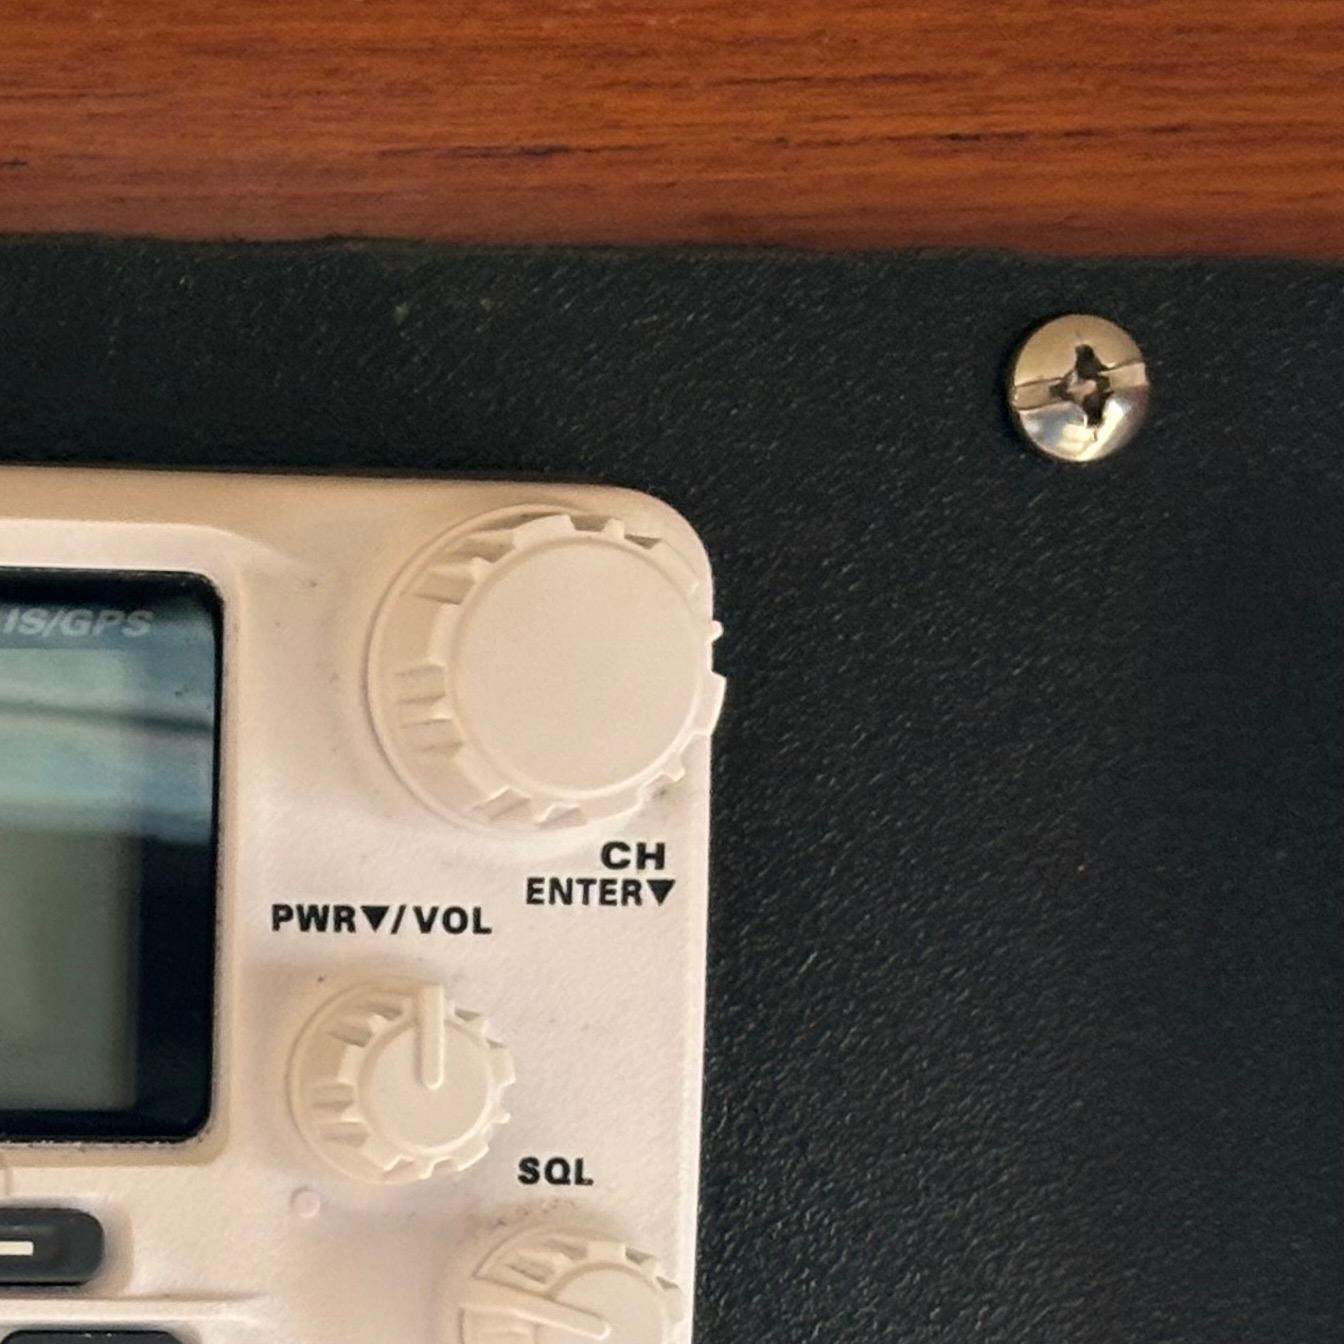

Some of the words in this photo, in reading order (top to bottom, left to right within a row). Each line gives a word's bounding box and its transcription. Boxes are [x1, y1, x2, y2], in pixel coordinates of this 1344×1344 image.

[600, 841, 666, 871] CH
[525, 877, 643, 907] ENTER
[517, 1156, 594, 1186] SQL
